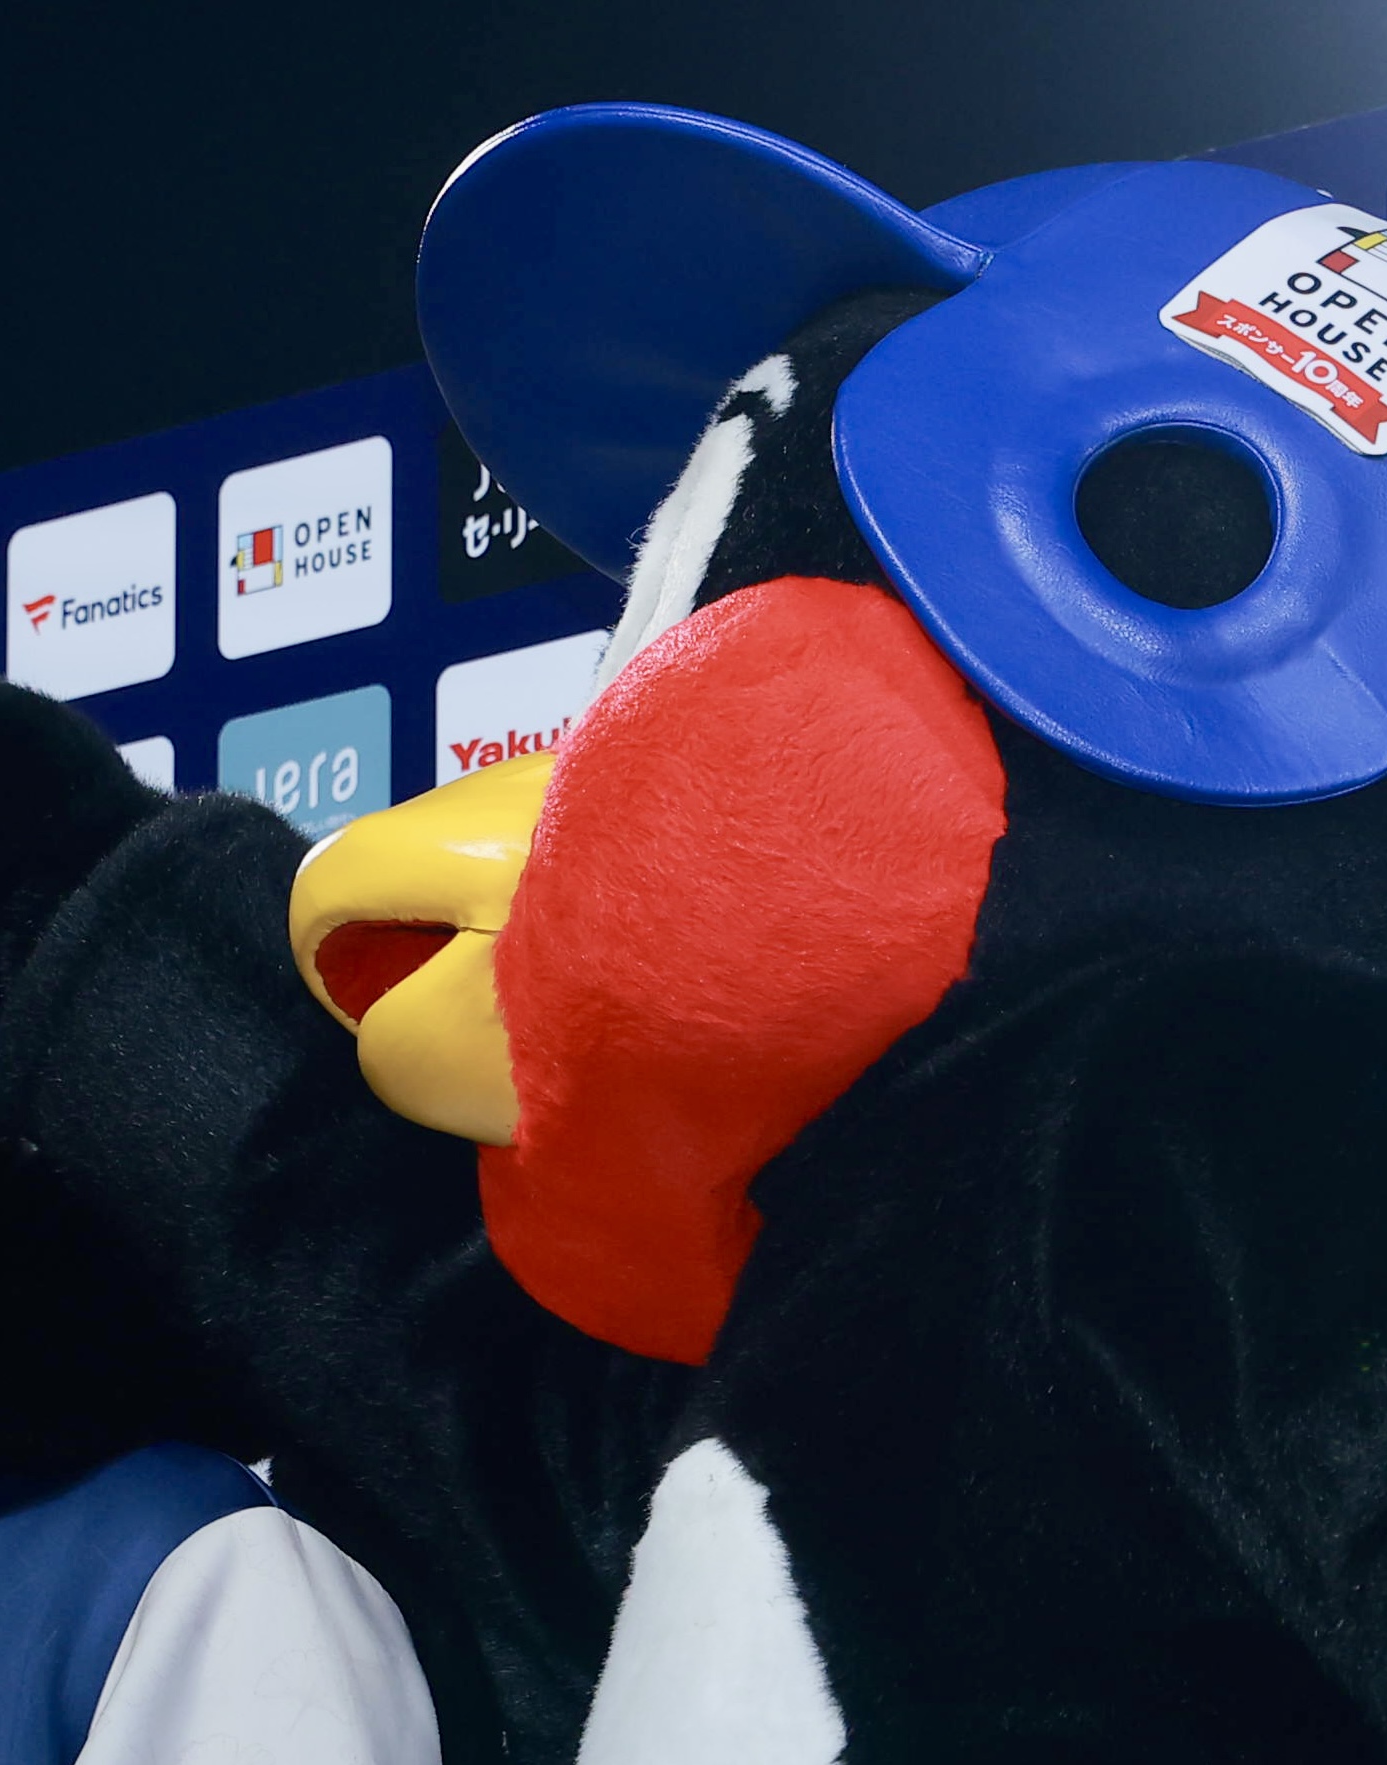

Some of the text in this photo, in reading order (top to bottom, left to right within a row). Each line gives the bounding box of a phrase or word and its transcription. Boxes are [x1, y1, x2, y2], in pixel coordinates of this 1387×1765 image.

[294, 506, 372, 548] OPEN
[295, 539, 372, 578] HOUSE
[62, 583, 163, 629] Fanatics
[450, 727, 569, 771] Yaku
